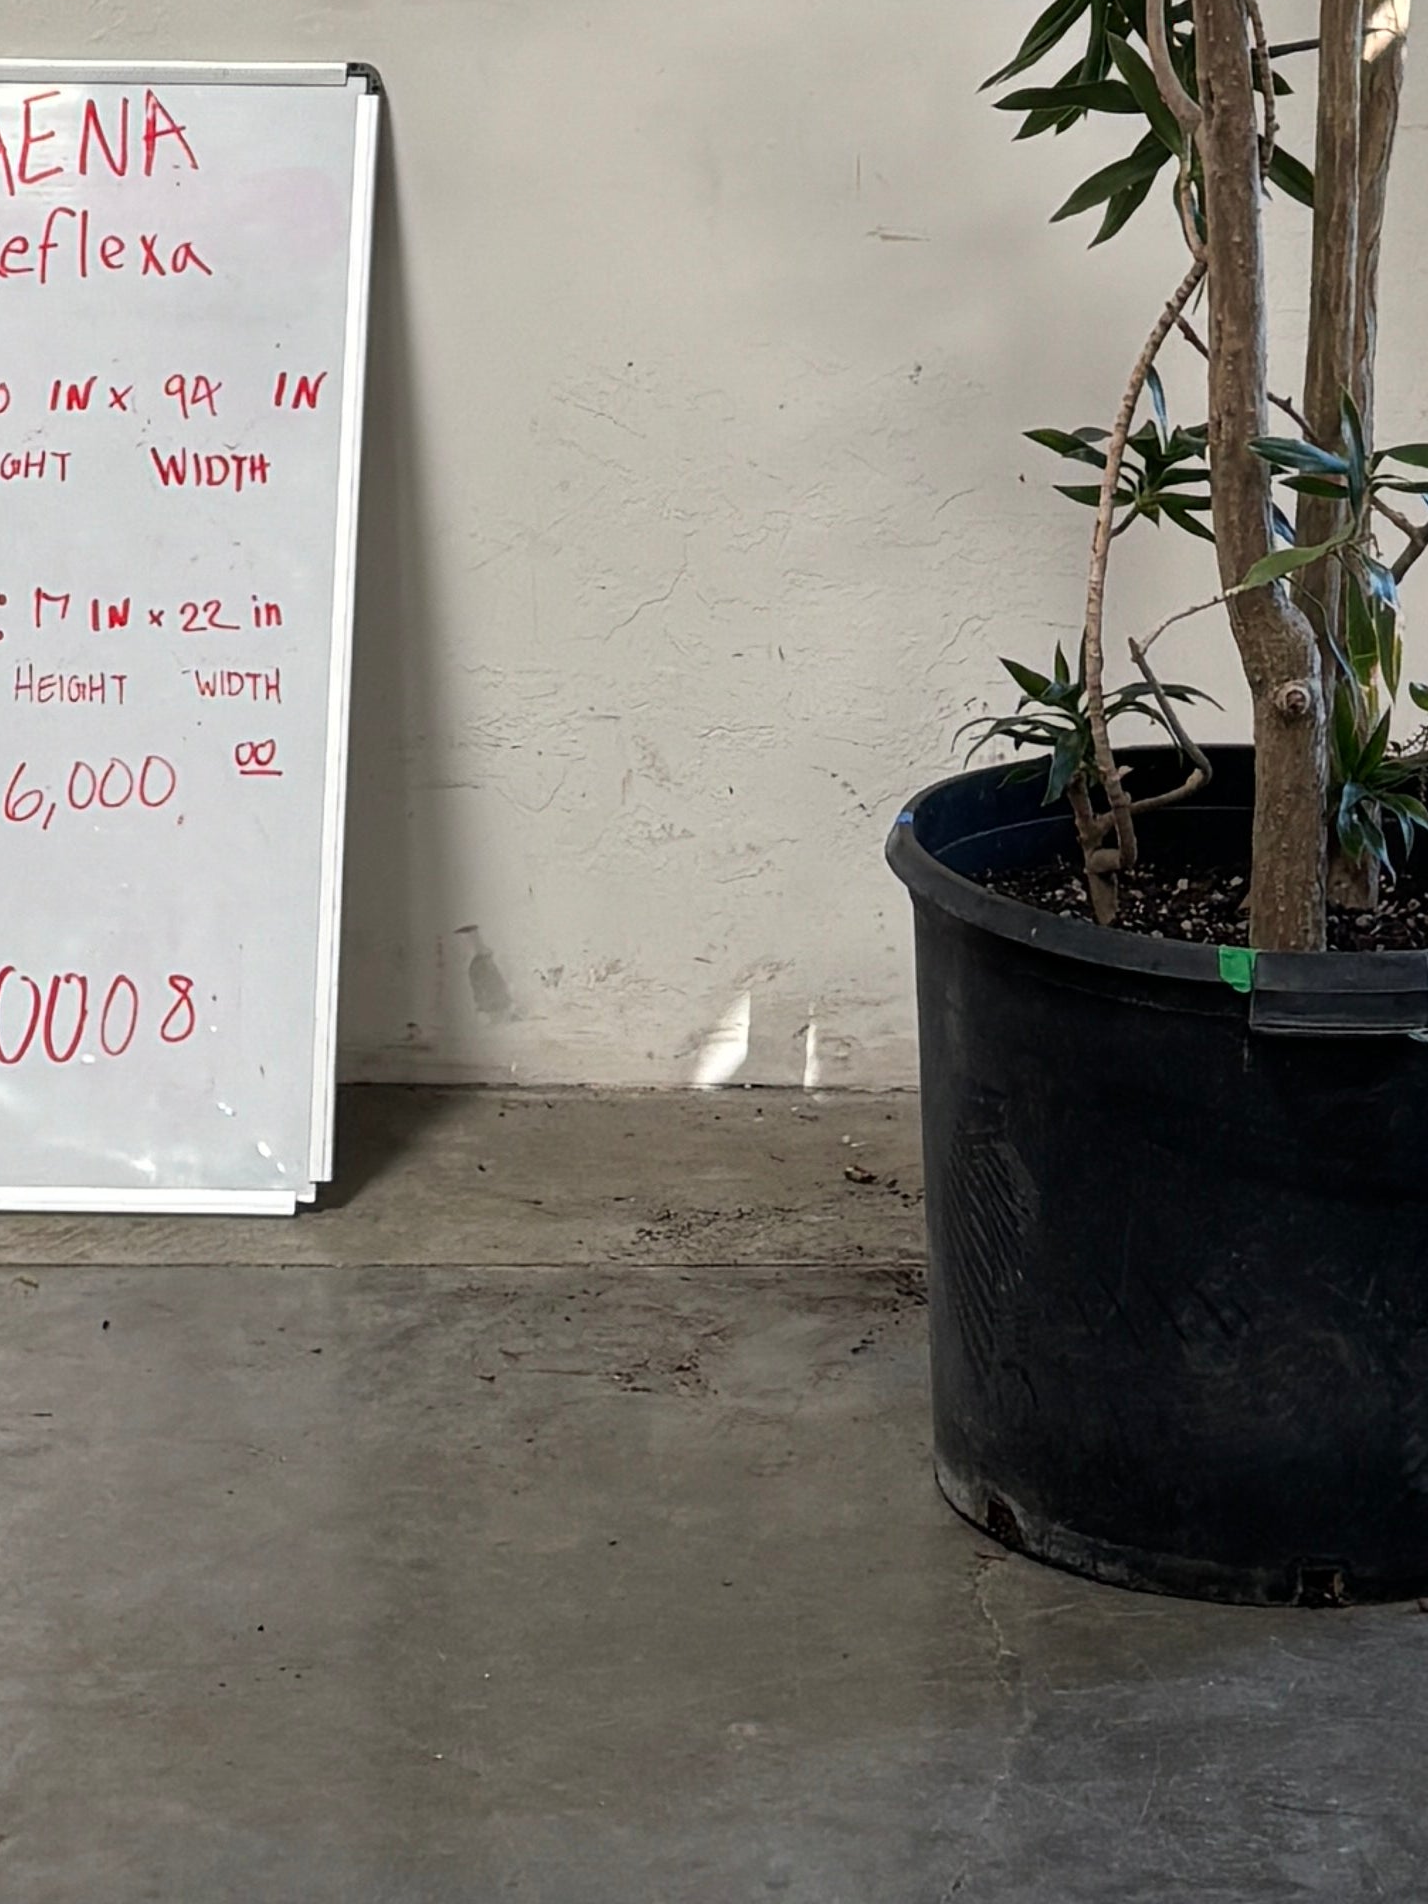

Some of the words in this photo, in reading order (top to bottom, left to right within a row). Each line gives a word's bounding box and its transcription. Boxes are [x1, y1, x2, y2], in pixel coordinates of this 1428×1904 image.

[48, 375, 98, 413] IN
[163, 374, 224, 420] 94
[272, 371, 329, 410] IN
[150, 447, 272, 493] WIDTH
[89, 596, 132, 632] IN
[178, 598, 241, 633] 22
[251, 593, 284, 629] in
[14, 662, 129, 706] HEIGHT
[194, 666, 282, 705] WIDTH
